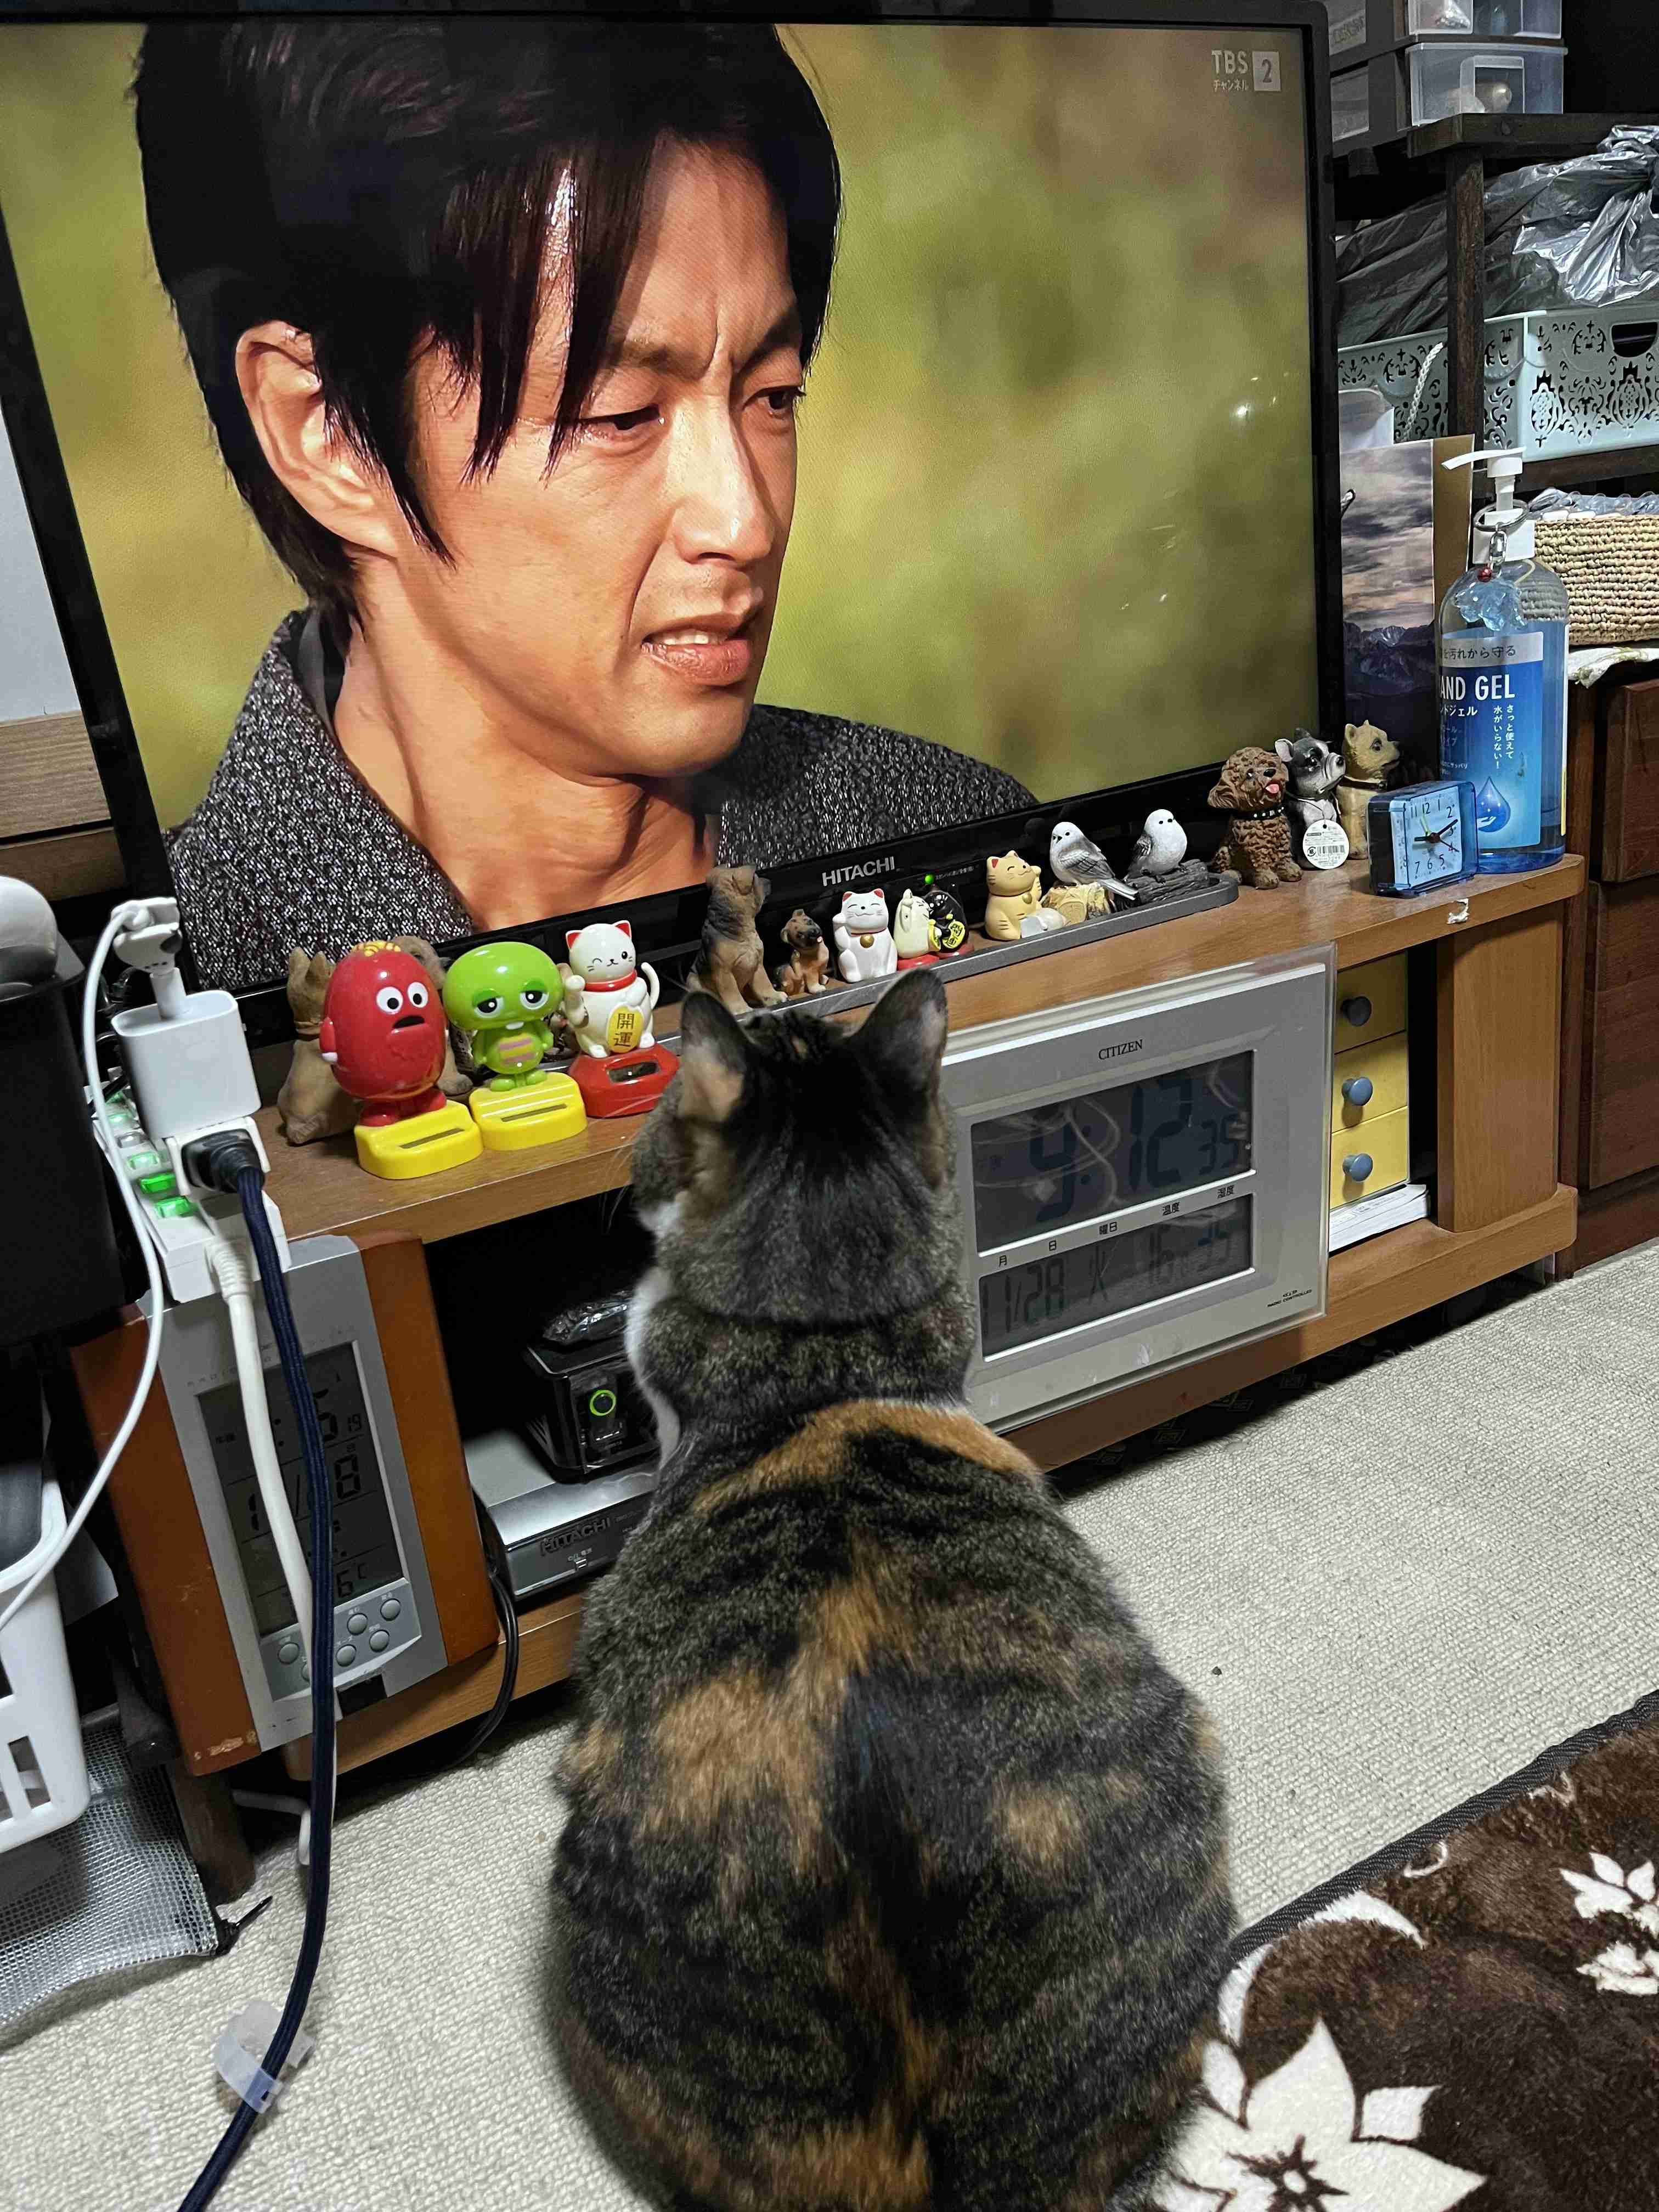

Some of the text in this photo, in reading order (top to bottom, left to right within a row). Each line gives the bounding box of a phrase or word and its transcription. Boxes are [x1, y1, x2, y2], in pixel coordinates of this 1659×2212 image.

[1211, 50, 1273, 83] TBS 2
[1212, 79, 1249, 93] チャンネル
[1475, 674, 1515, 701] GEL
[1505, 704, 1515, 759] さっと使えて
[1411, 805, 1418, 819] 11
[1422, 802, 1431, 815] 12
[1446, 806, 1453, 819] 2
[1414, 861, 1420, 874] 7
[1427, 857, 1433, 870] 6
[1439, 854, 1444, 867] 5
[822, 856, 895, 887] HITACHI
[613, 1013, 634, 1047] 開運
[1098, 1039, 1143, 1060] CITIZEN
[998, 1255, 1007, 1266] 月
[1048, 1240, 1057, 1251] 日
[1099, 1222, 1118, 1235] 曜日
[1162, 1202, 1181, 1216] 温度
[540, 1517, 611, 1557] HITACHI
